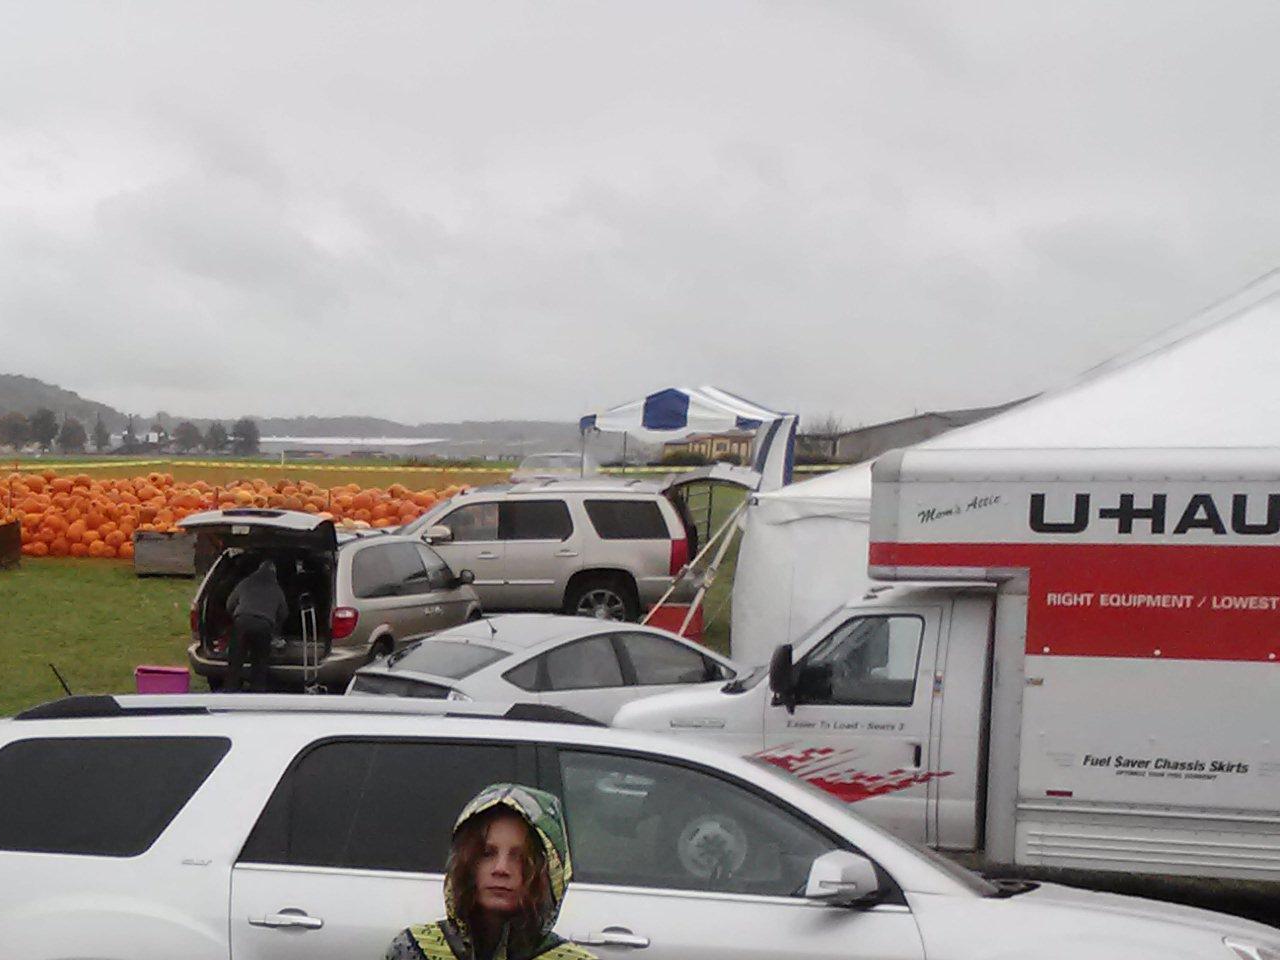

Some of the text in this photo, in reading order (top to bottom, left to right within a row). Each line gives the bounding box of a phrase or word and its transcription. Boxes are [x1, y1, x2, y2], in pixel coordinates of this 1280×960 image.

[1047, 592, 1095, 606] RIGHT
[1099, 594, 1194, 609] EQUIPMENT
[1211, 595, 1279, 609] LOWEST
[1083, 754, 1112, 767] Fuel
[1154, 758, 1206, 772] Chassis
[1209, 761, 1250, 774] Skirts
